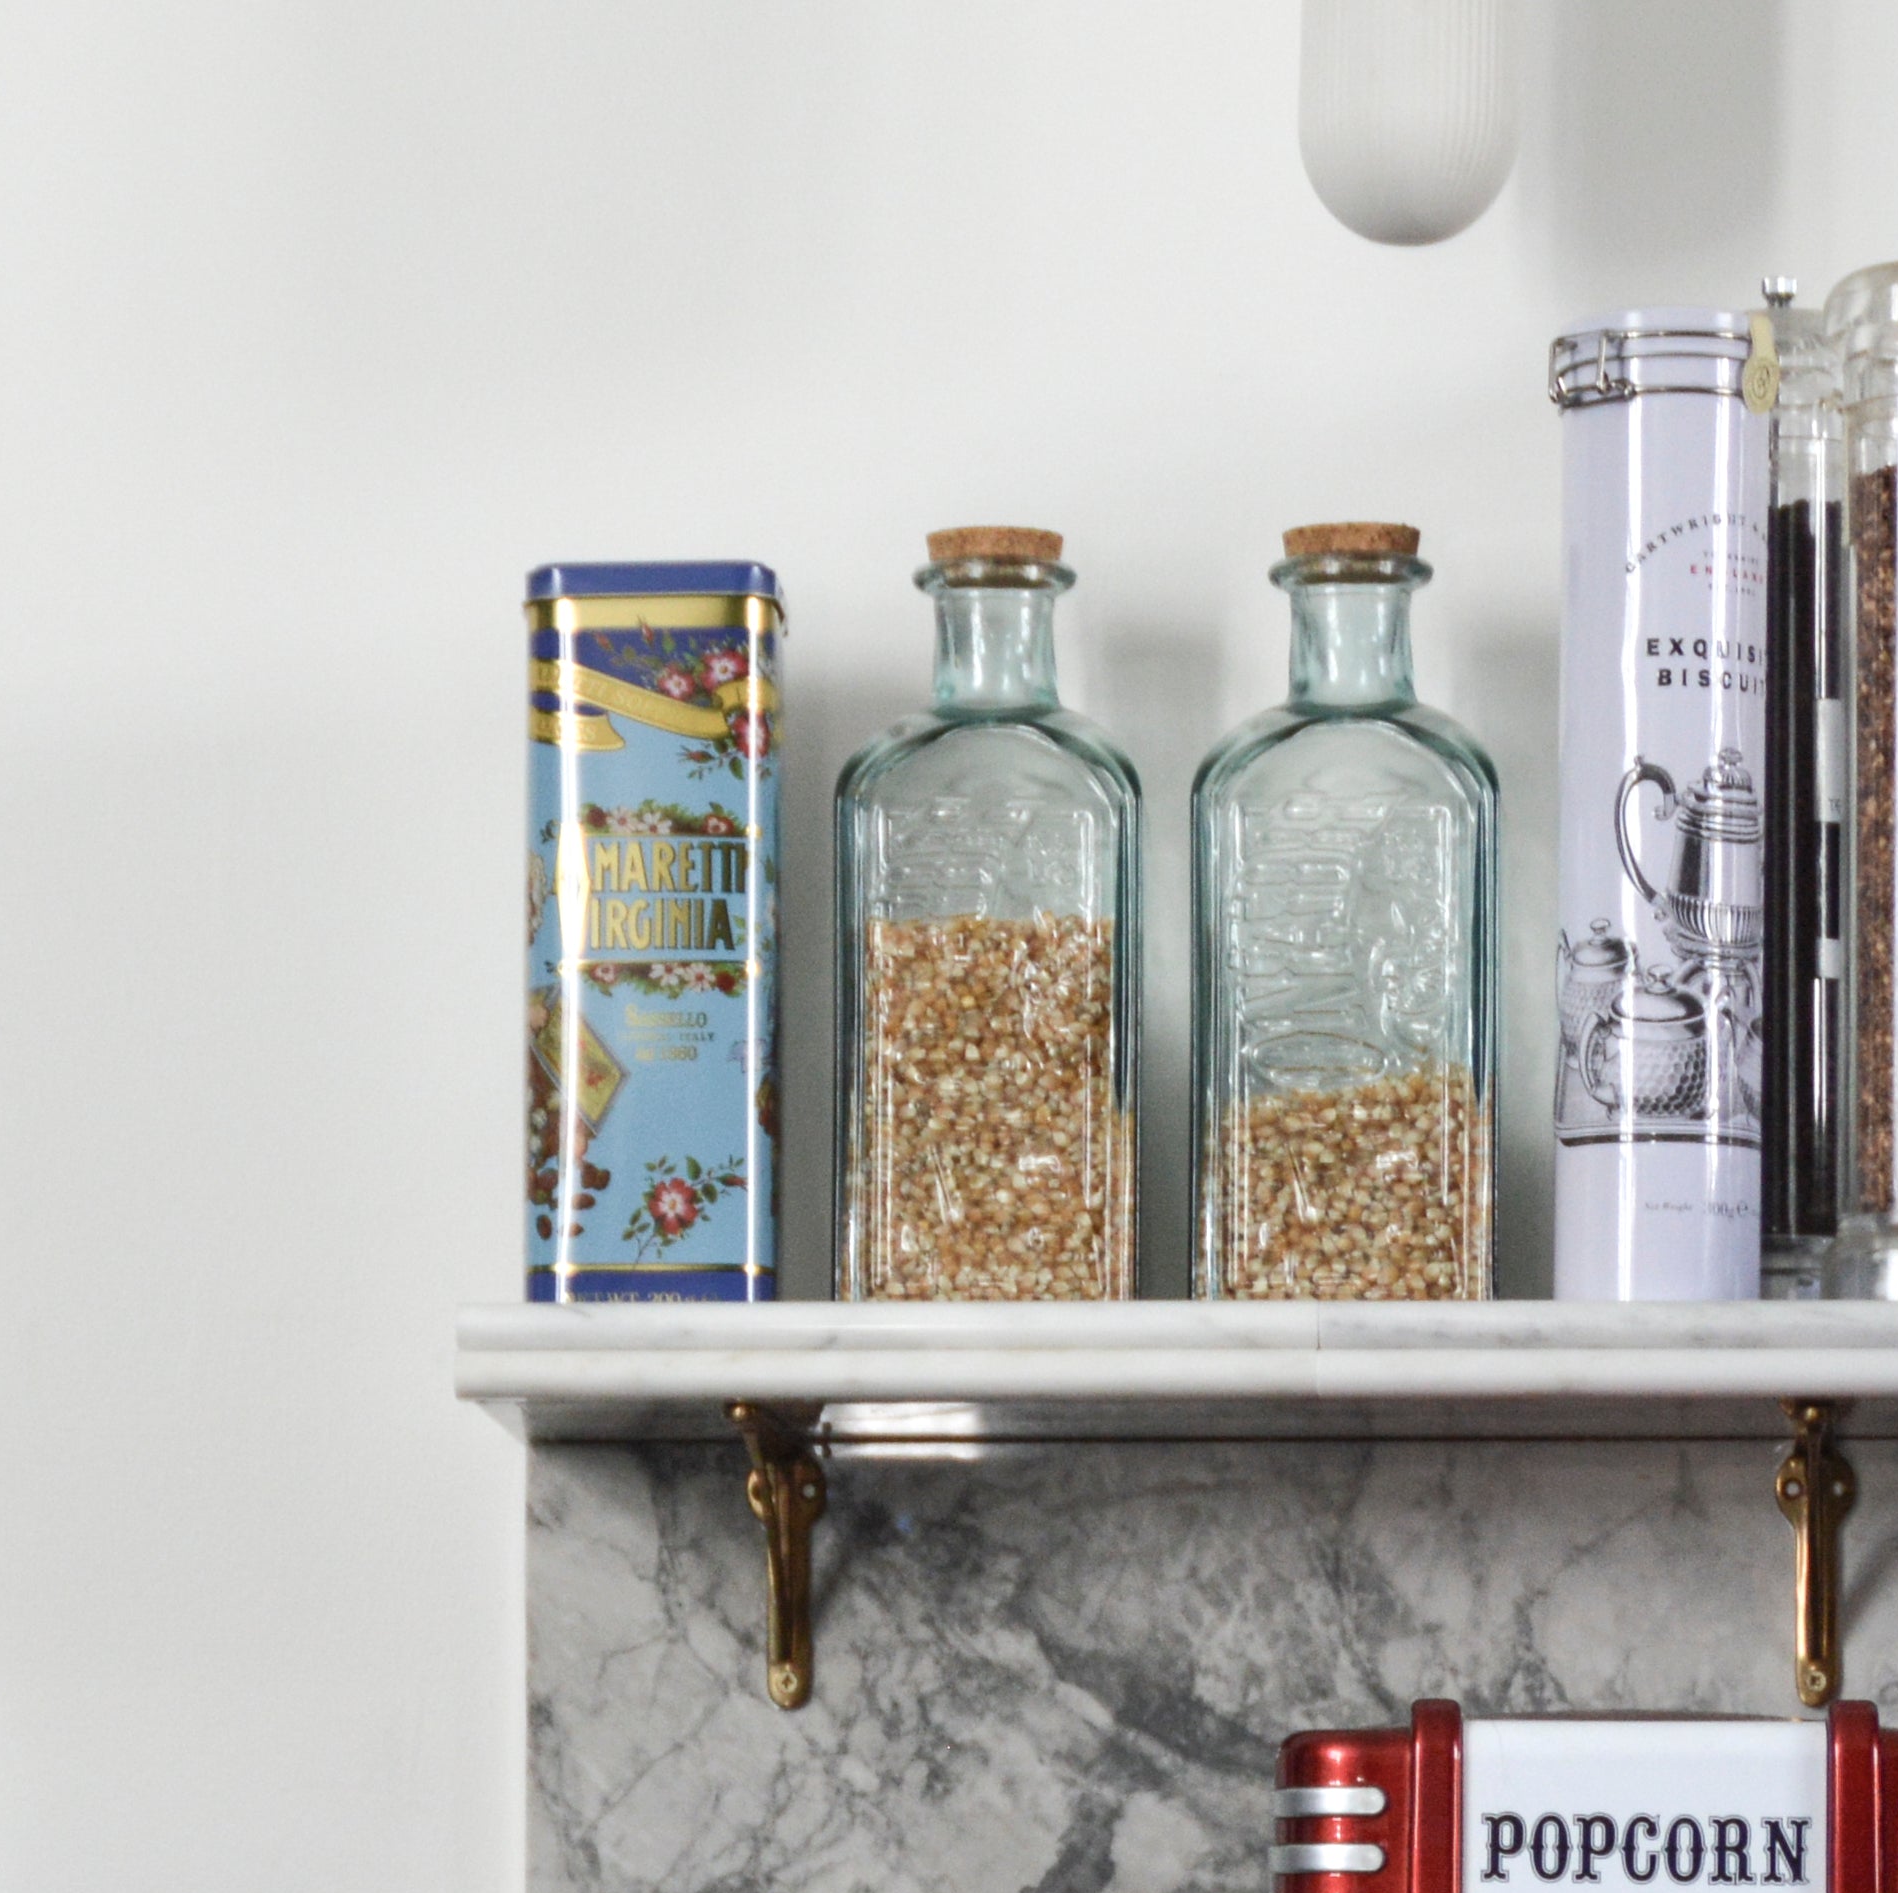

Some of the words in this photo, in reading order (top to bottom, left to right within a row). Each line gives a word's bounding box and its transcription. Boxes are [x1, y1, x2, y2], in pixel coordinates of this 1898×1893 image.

[554, 840, 749, 893] MARETTI
[578, 898, 736, 951] IRGINIA
[1481, 1811, 1813, 1887] POPCORN
